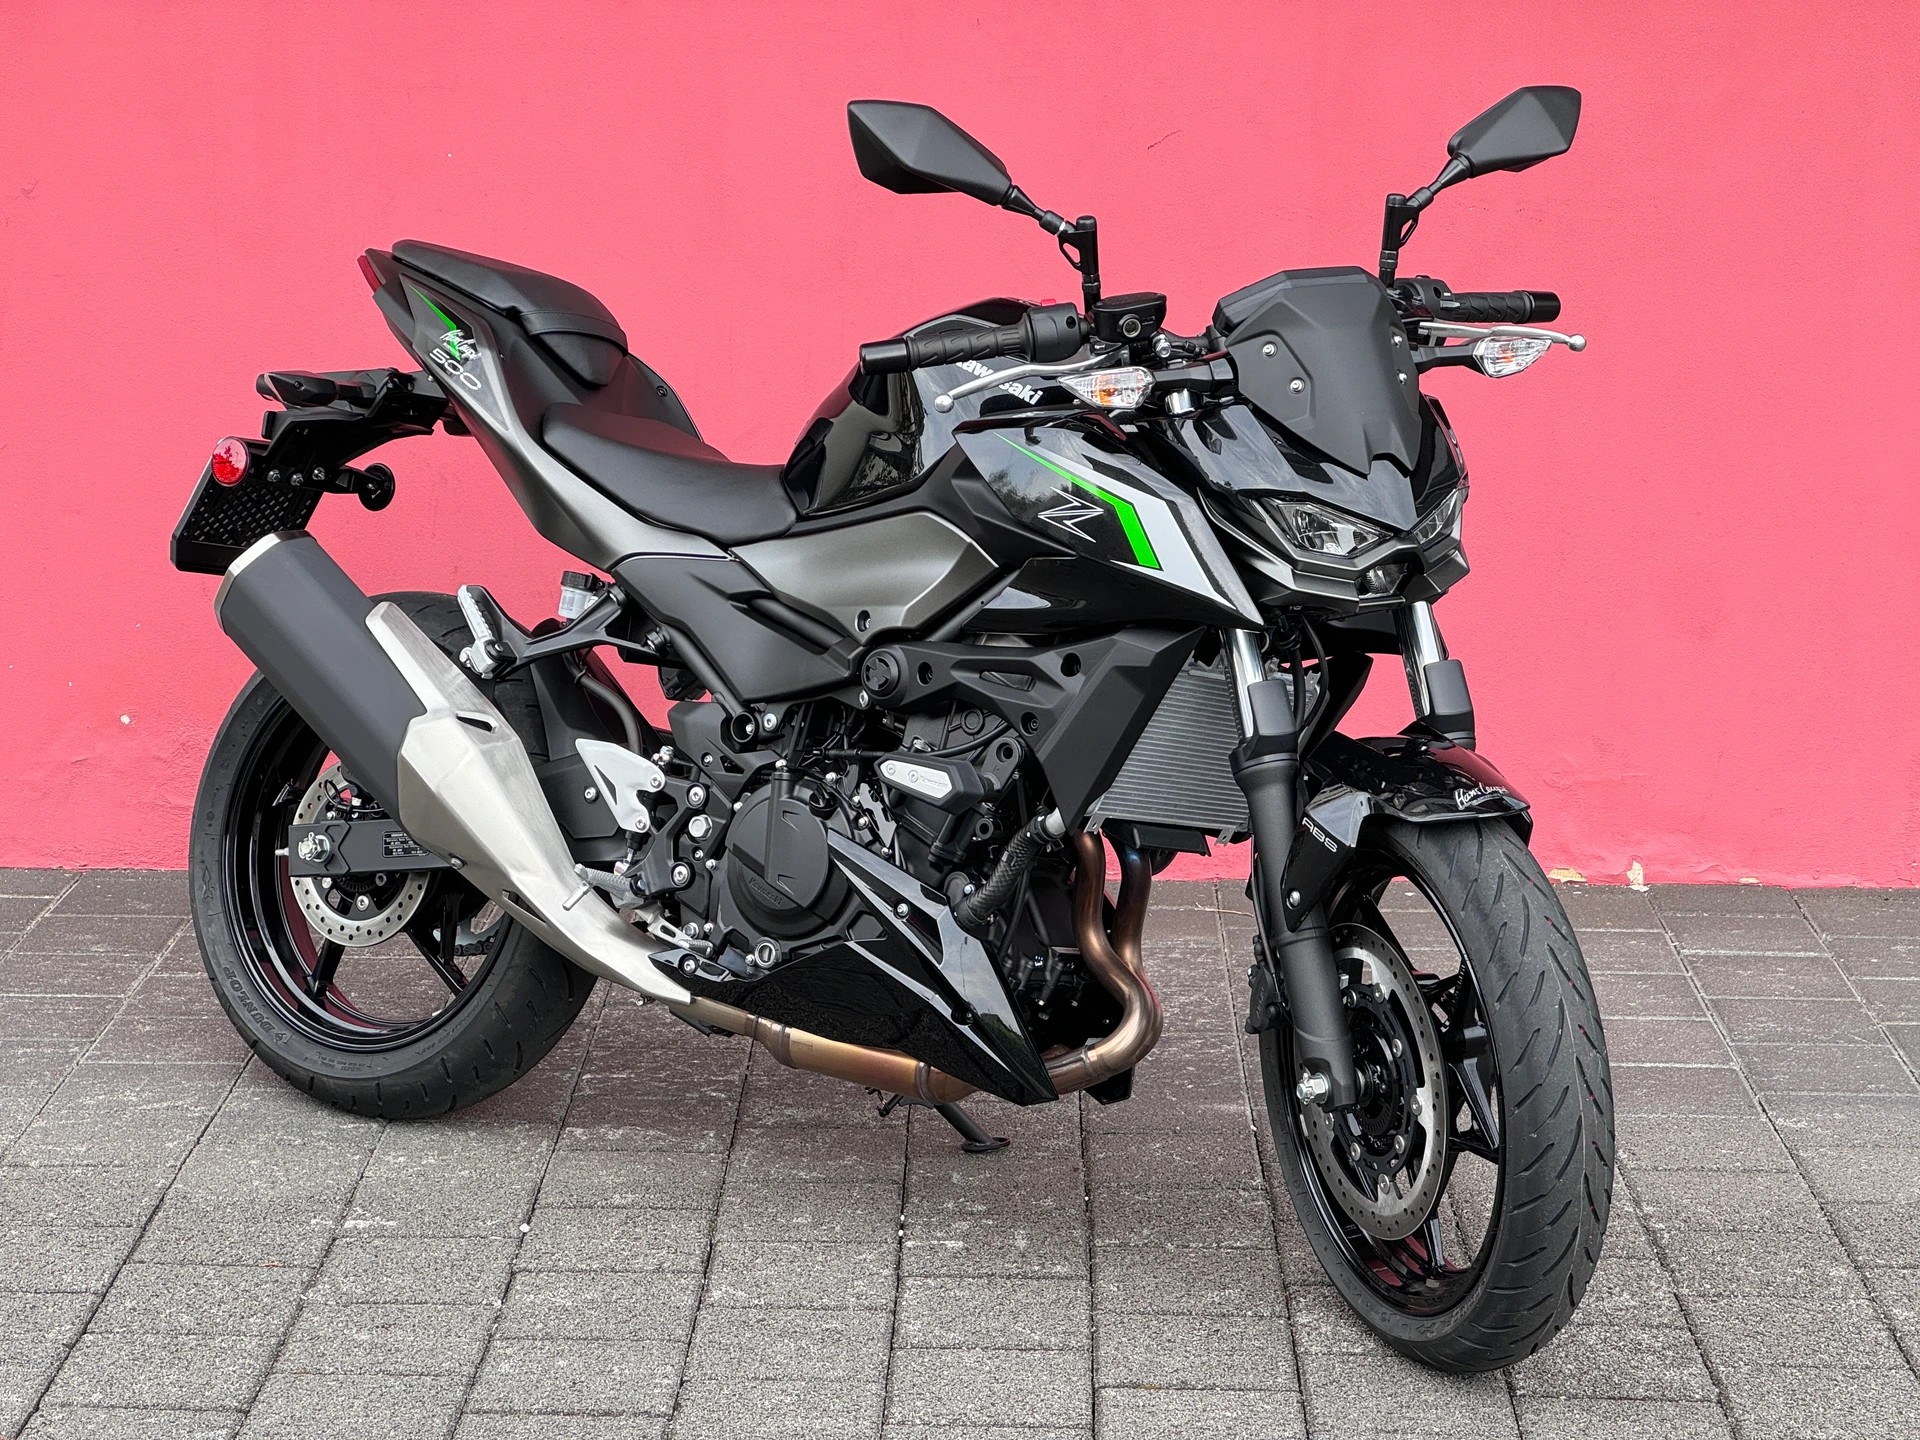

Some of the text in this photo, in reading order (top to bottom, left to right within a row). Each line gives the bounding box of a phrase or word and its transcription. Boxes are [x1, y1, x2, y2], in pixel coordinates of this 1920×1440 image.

[430, 347, 482, 390] 500
[1302, 817, 1338, 852] ABS
[222, 966, 276, 1033] DUNLOP
